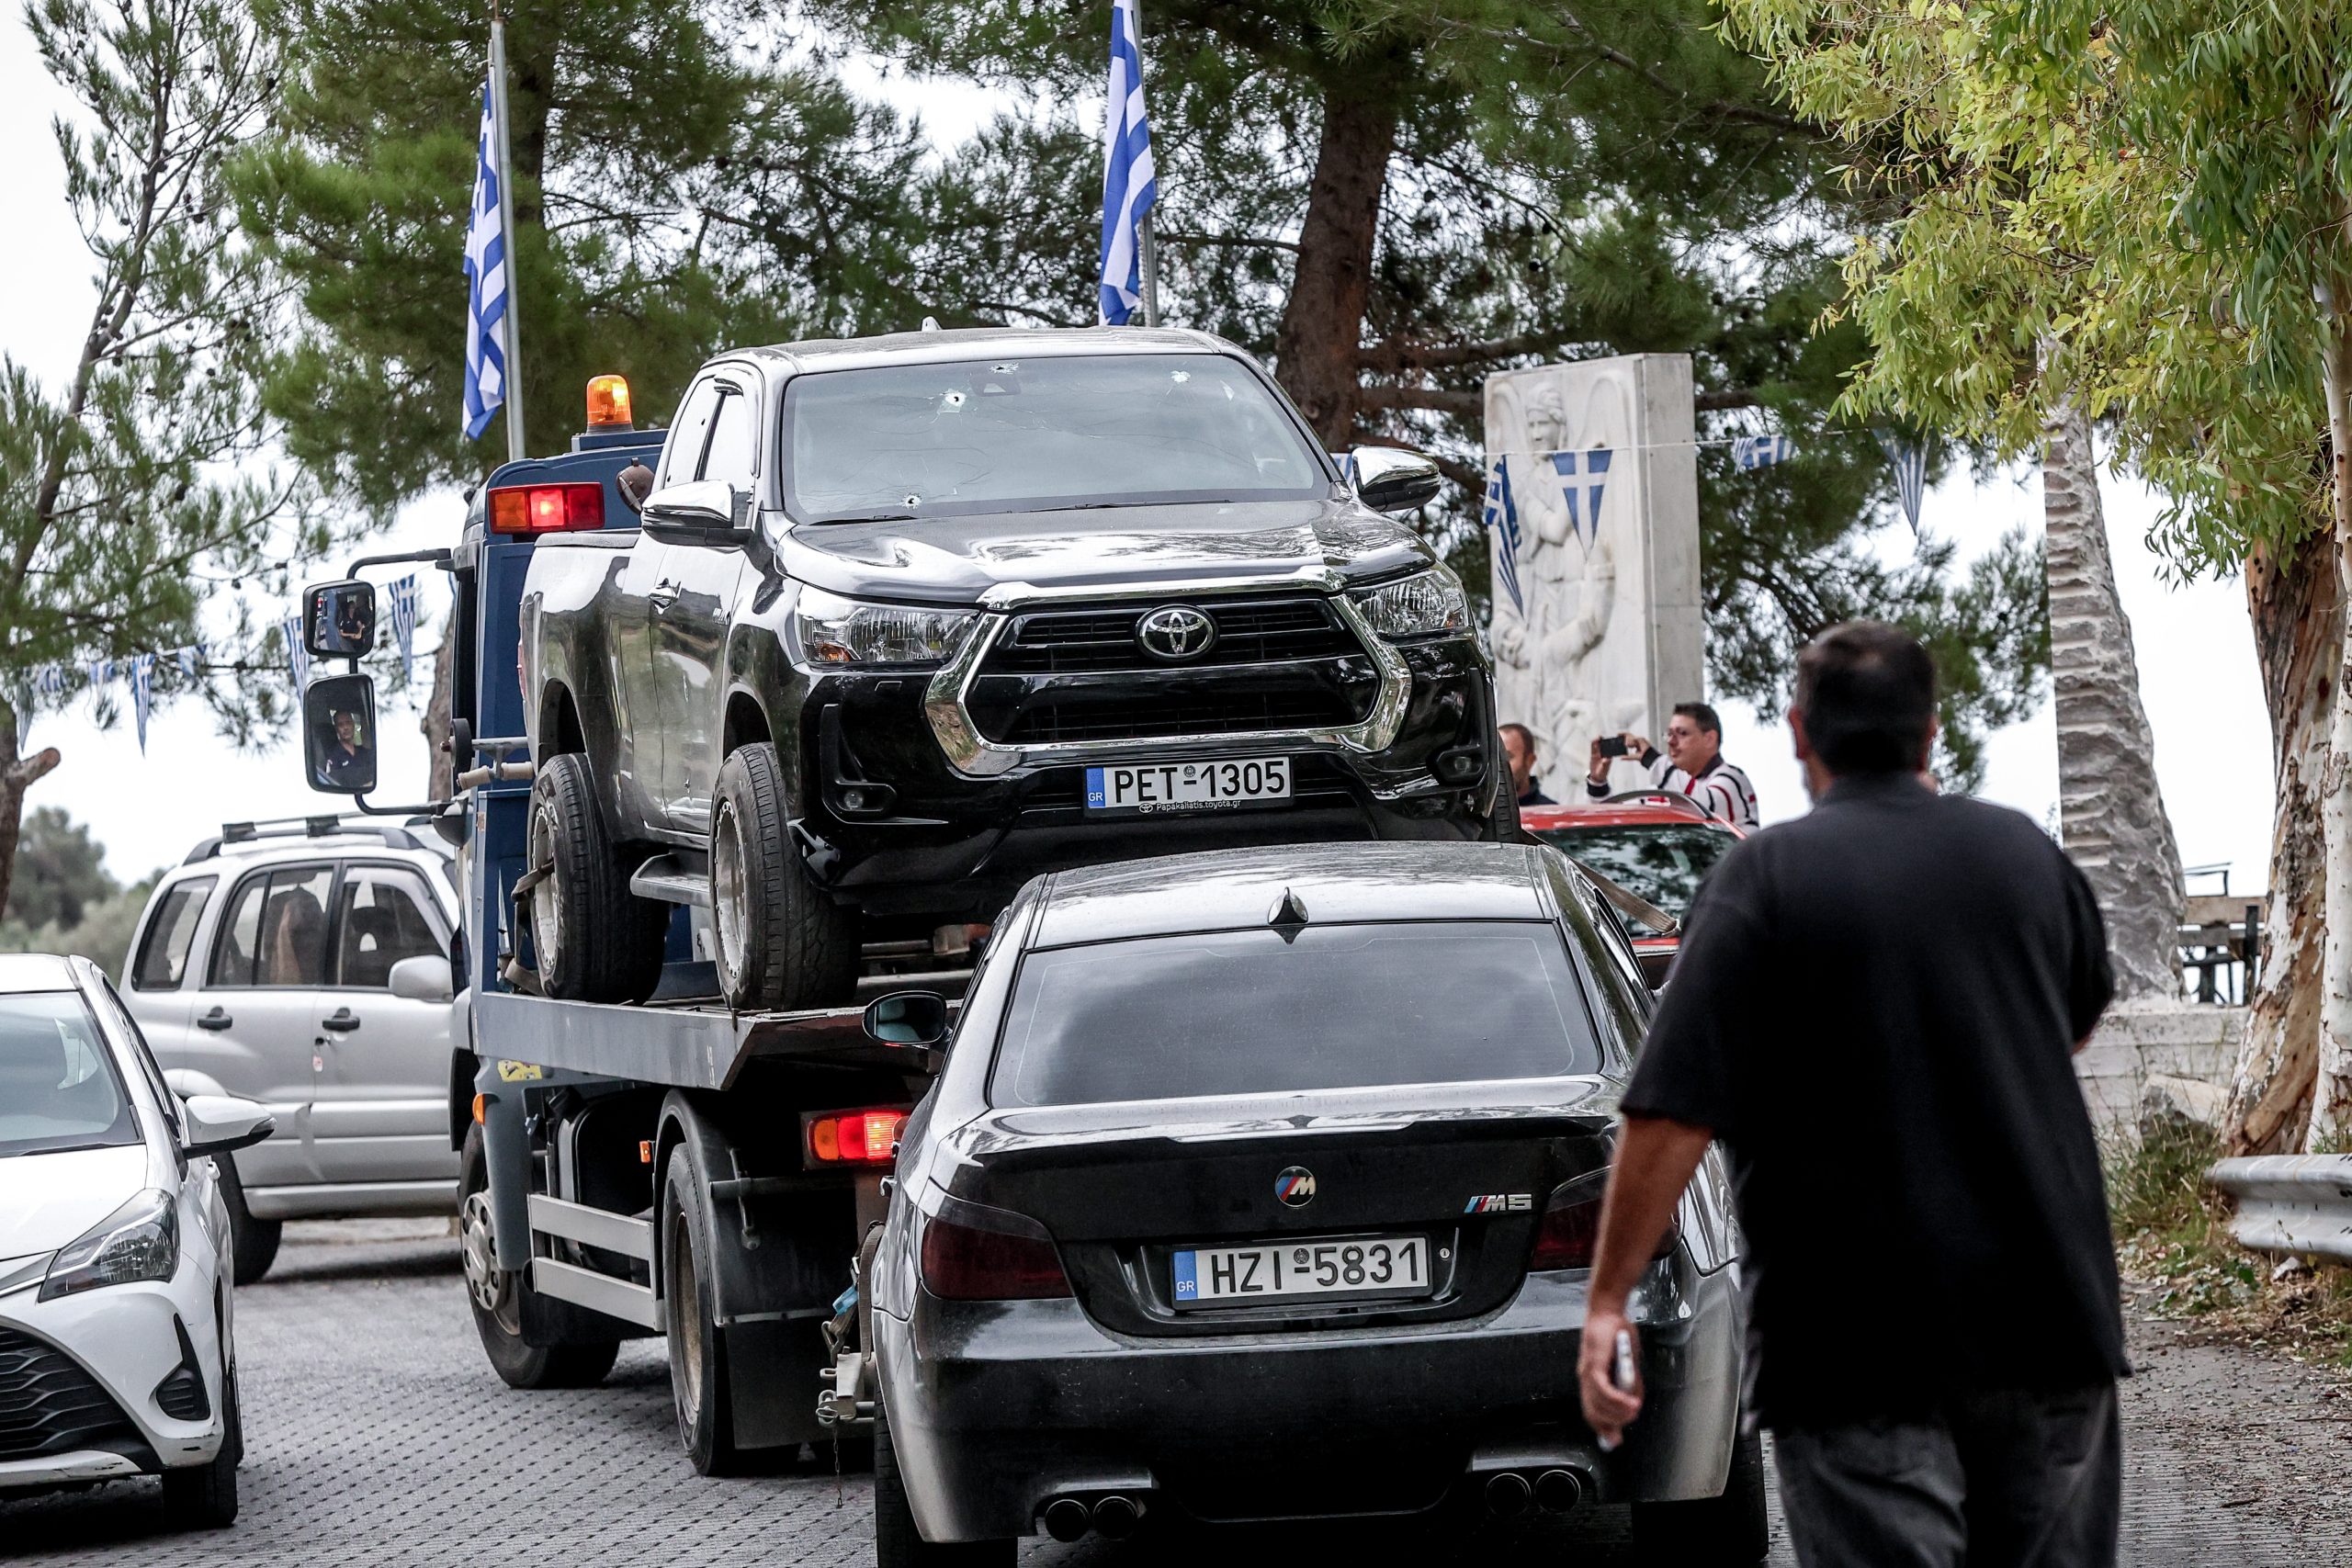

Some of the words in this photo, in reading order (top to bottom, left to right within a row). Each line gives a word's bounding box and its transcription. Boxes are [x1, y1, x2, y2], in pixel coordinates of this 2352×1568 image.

[1114, 761, 1285, 804] PET-1305
[1088, 792, 1103, 802] GR
[1289, 1176, 1316, 1195] M
[1481, 1193, 1532, 1213] M5
[1210, 1240, 1419, 1294] HZI-5831
[1176, 1280, 1195, 1292] GR
